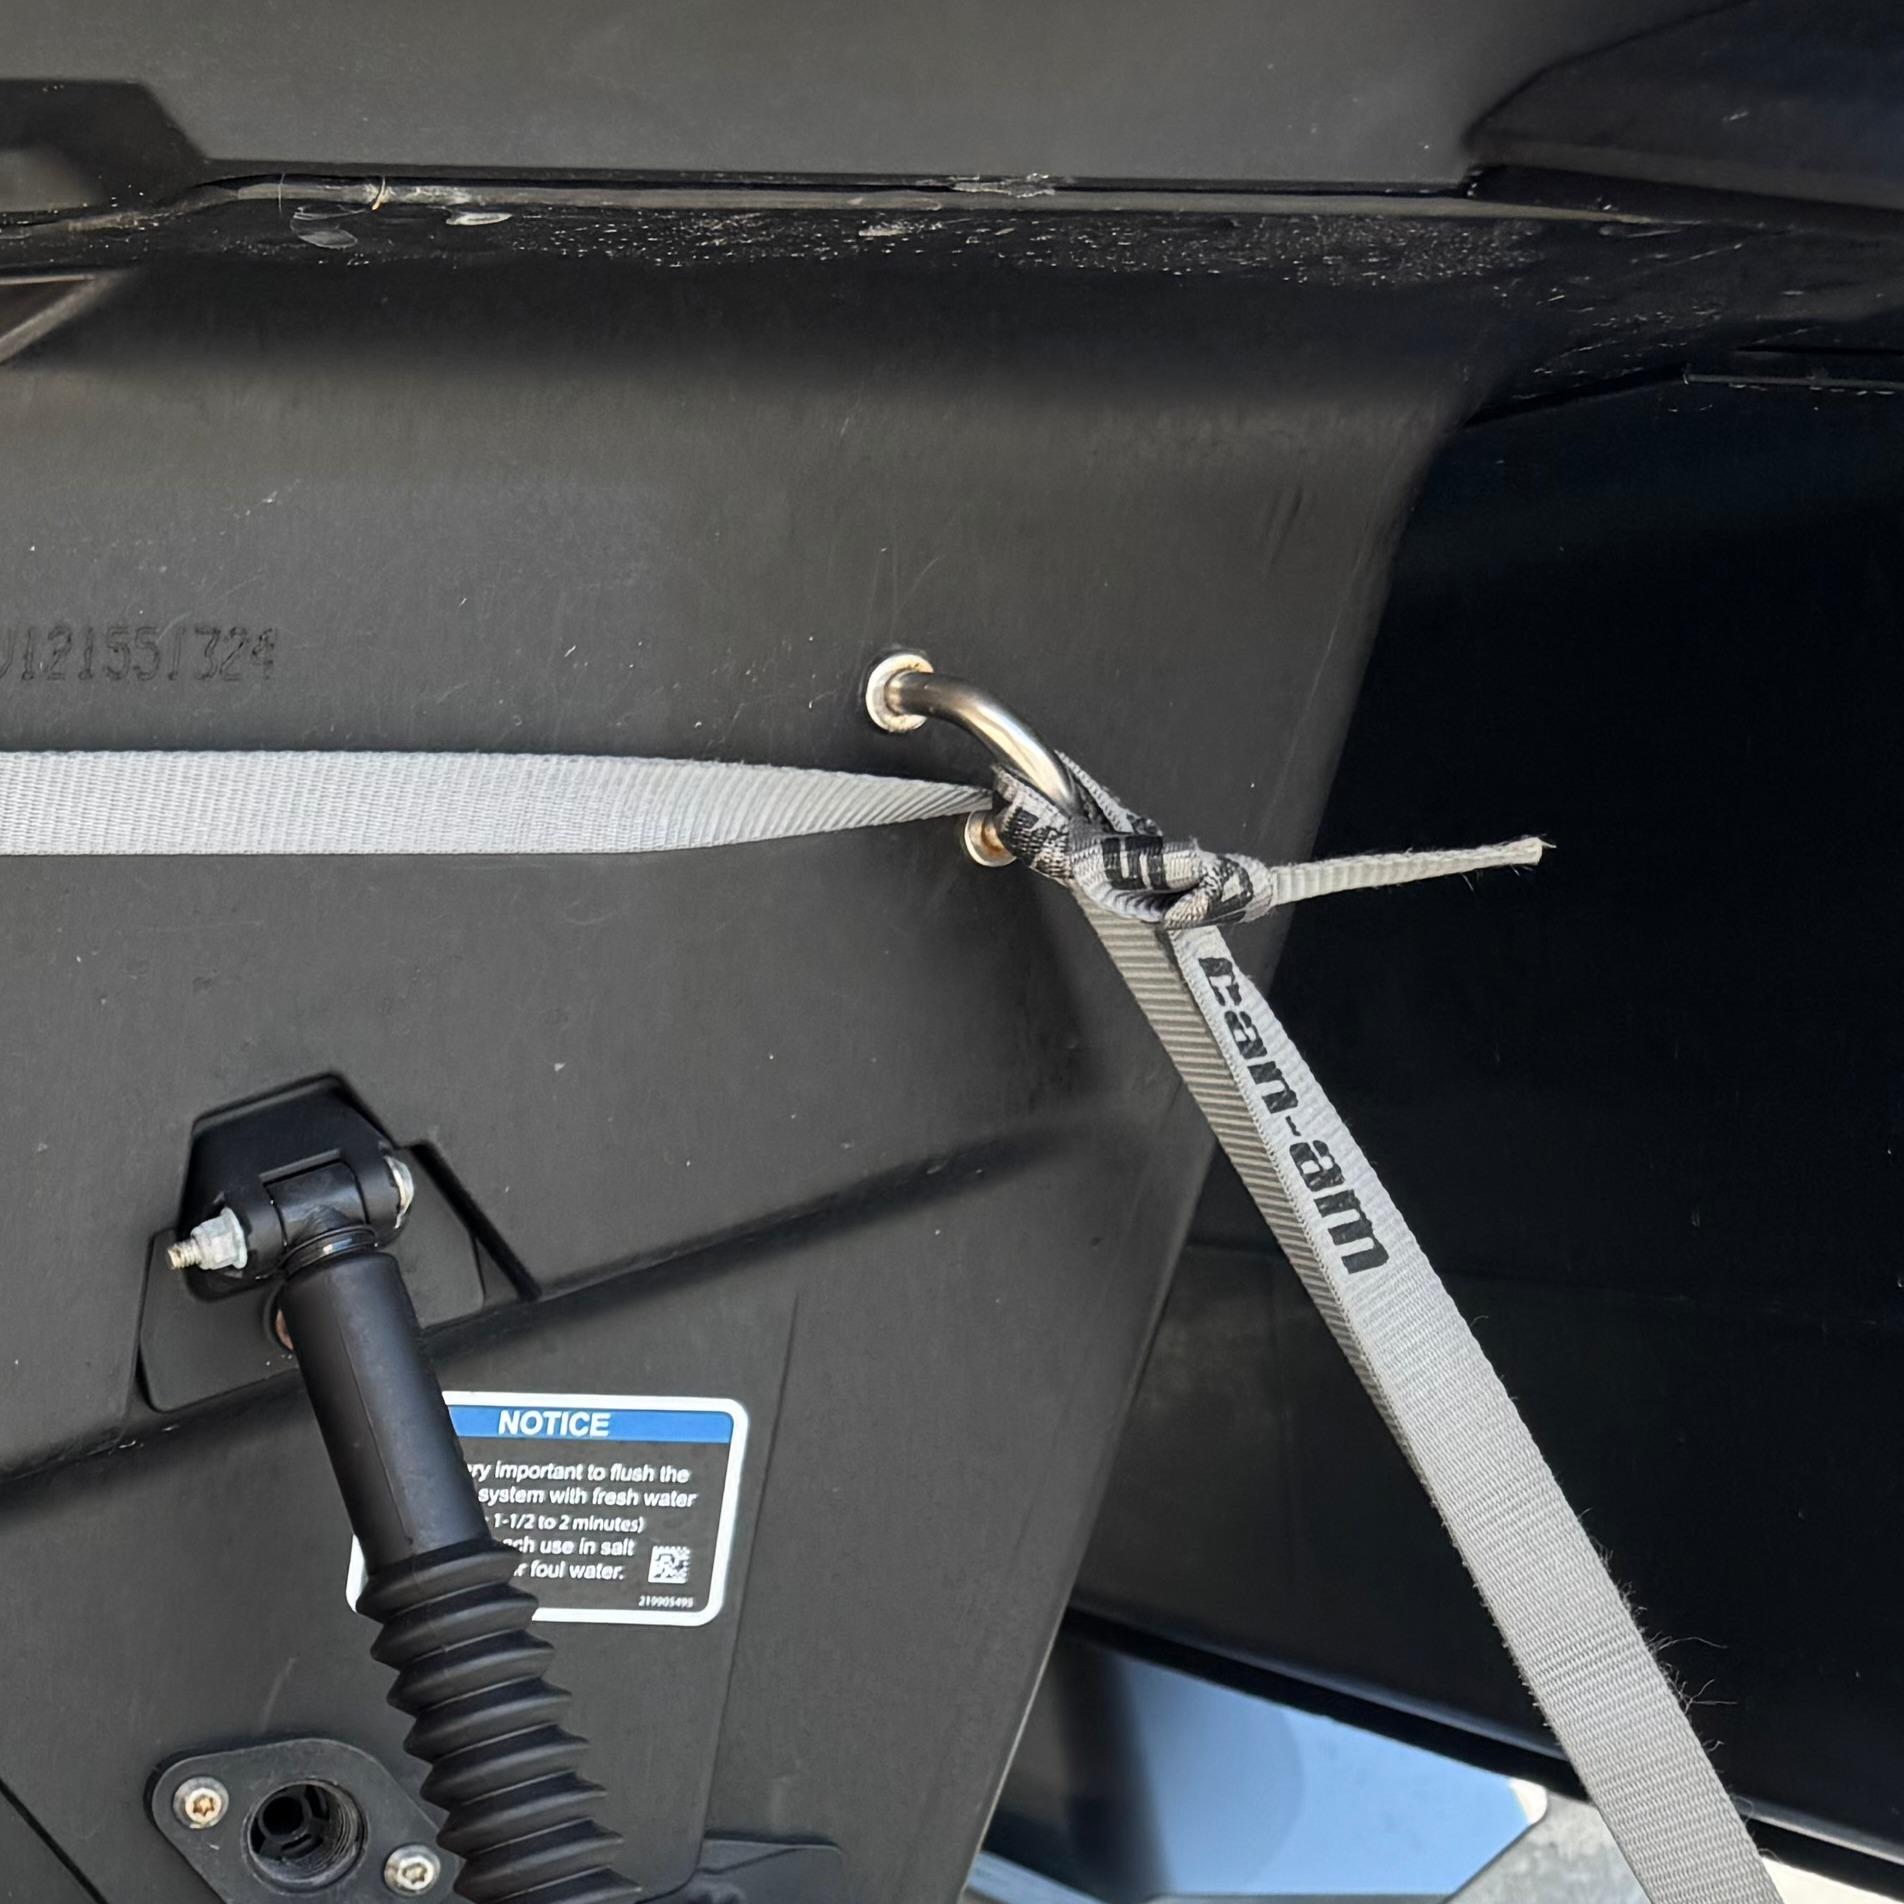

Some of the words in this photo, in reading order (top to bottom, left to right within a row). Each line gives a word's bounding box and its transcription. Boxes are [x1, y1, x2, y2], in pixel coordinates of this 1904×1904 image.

[497, 1409, 611, 1438] NOTICE
[467, 1463, 491, 1482] ry
[495, 1460, 584, 1482] important
[588, 1464, 607, 1481] to
[610, 1463, 655, 1482] flush
[659, 1465, 691, 1483] the
[477, 1486, 545, 1506] system
[549, 1487, 589, 1504] with
[592, 1486, 639, 1506] fresh
[644, 1490, 698, 1507] water
[494, 1513, 536, 1530] 1-1/2
[538, 1515, 557, 1529] to
[558, 1515, 571, 1530] 2
[572, 1516, 645, 1534] minutes)
[539, 1540, 575, 1554] use
[578, 1537, 598, 1554] in
[600, 1537, 636, 1556] salt
[530, 1560, 566, 1578] foul
[569, 1562, 625, 1580] water.
